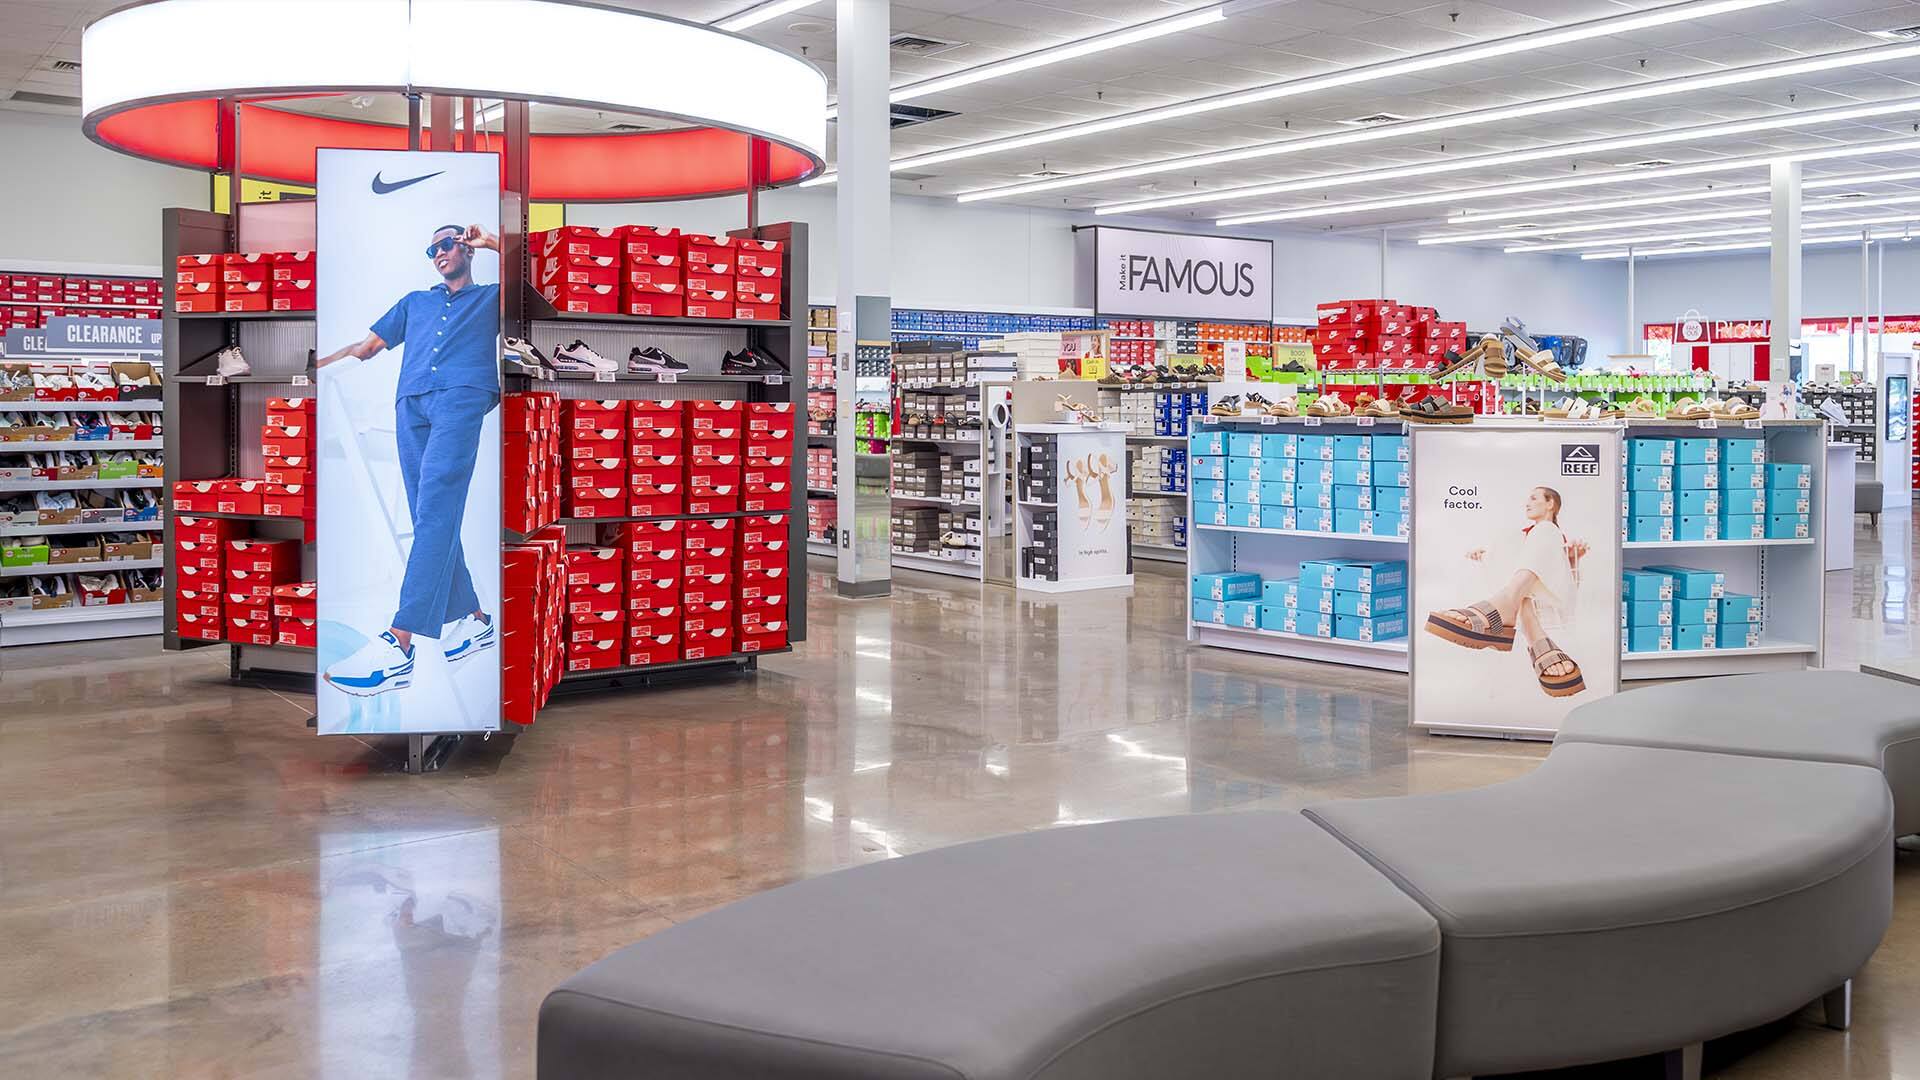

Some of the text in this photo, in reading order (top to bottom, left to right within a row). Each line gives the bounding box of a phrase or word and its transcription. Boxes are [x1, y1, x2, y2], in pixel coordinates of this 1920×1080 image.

[1119, 254, 1127, 291] Make it
[1128, 254, 1255, 298] FAMOUS
[67, 325, 144, 344] CLEARANCE
[1563, 463, 1598, 474] REEF
[1448, 485, 1478, 496] Cool
[1443, 498, 1483, 510] factor.
